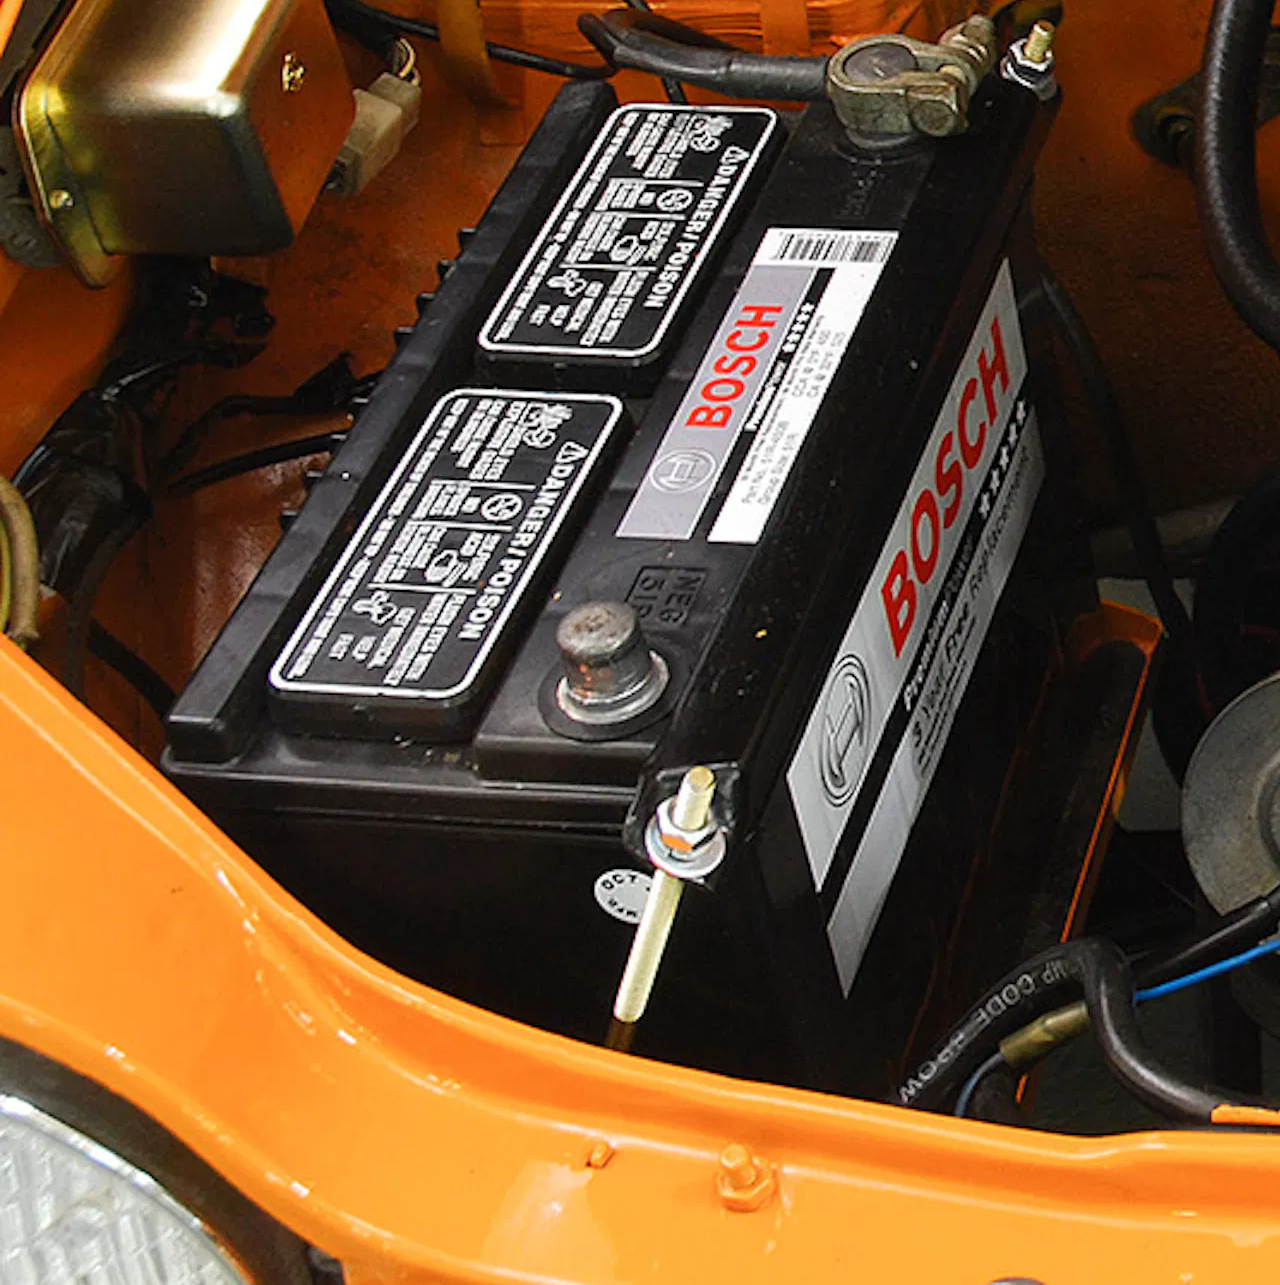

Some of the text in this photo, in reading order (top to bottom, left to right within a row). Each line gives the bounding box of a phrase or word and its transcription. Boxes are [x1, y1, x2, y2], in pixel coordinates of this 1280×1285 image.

[683, 304, 784, 428] BOSCH
[880, 310, 1010, 663] BOSCH
[660, 576, 700, 625] NEG
[973, 972, 1036, 1027] CODE
